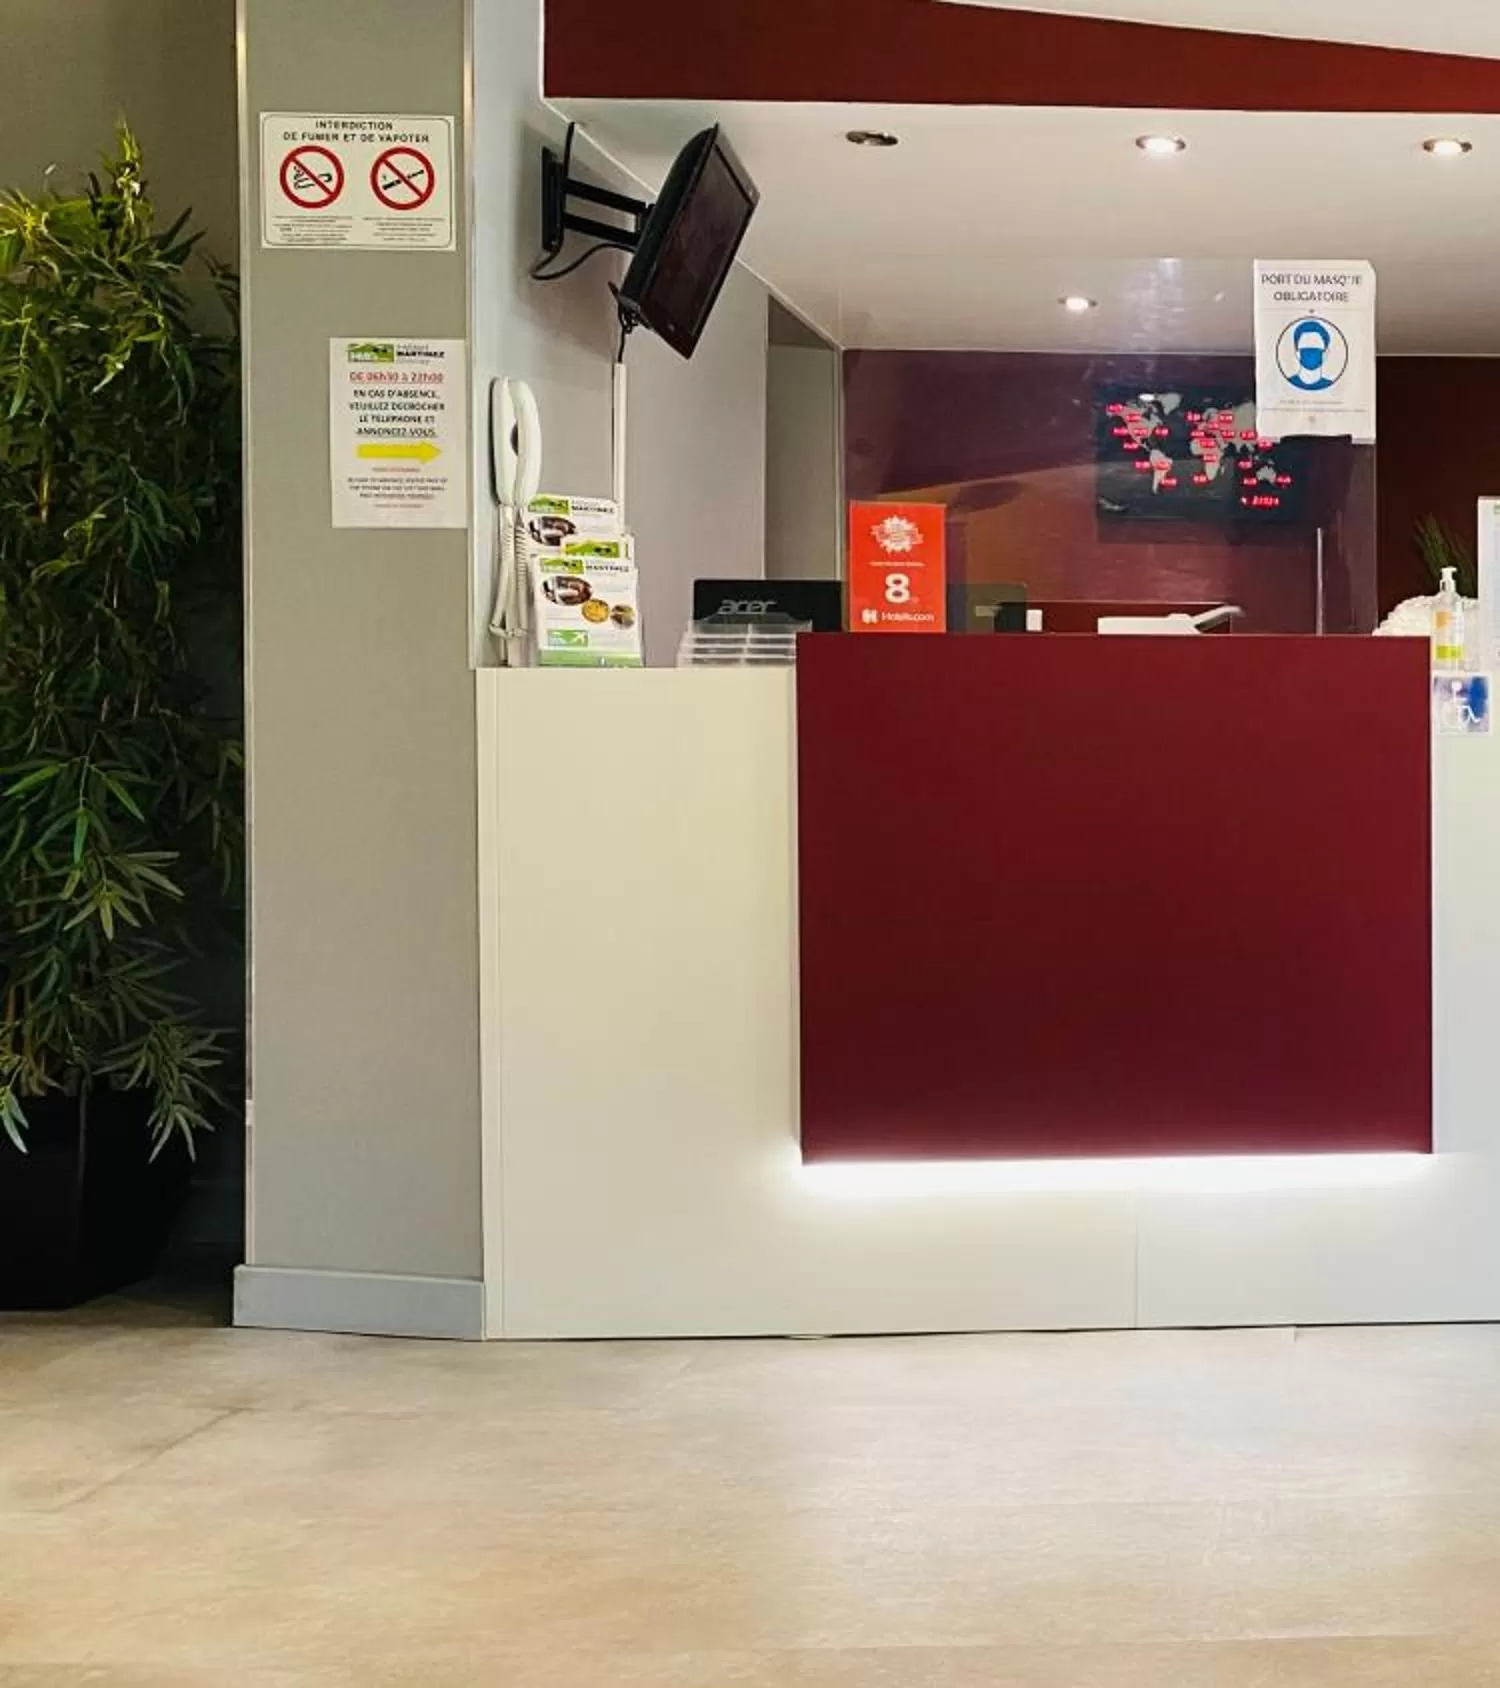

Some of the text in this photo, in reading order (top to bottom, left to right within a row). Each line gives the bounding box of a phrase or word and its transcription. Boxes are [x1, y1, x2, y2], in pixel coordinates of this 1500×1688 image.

[315, 120, 393, 131] INTERDICTION
[283, 131, 430, 143] DE FUMER ET DE VAPOTER
[1261, 273, 1292, 286] PORT
[1294, 274, 1311, 286] DU
[1273, 291, 1350, 303] OBLIGATOIRE
[353, 389, 366, 399] EN
[368, 389, 385, 399] CAS
[359, 415, 369, 423] LE
[885, 573, 910, 604] 8
[717, 599, 777, 615] acer
